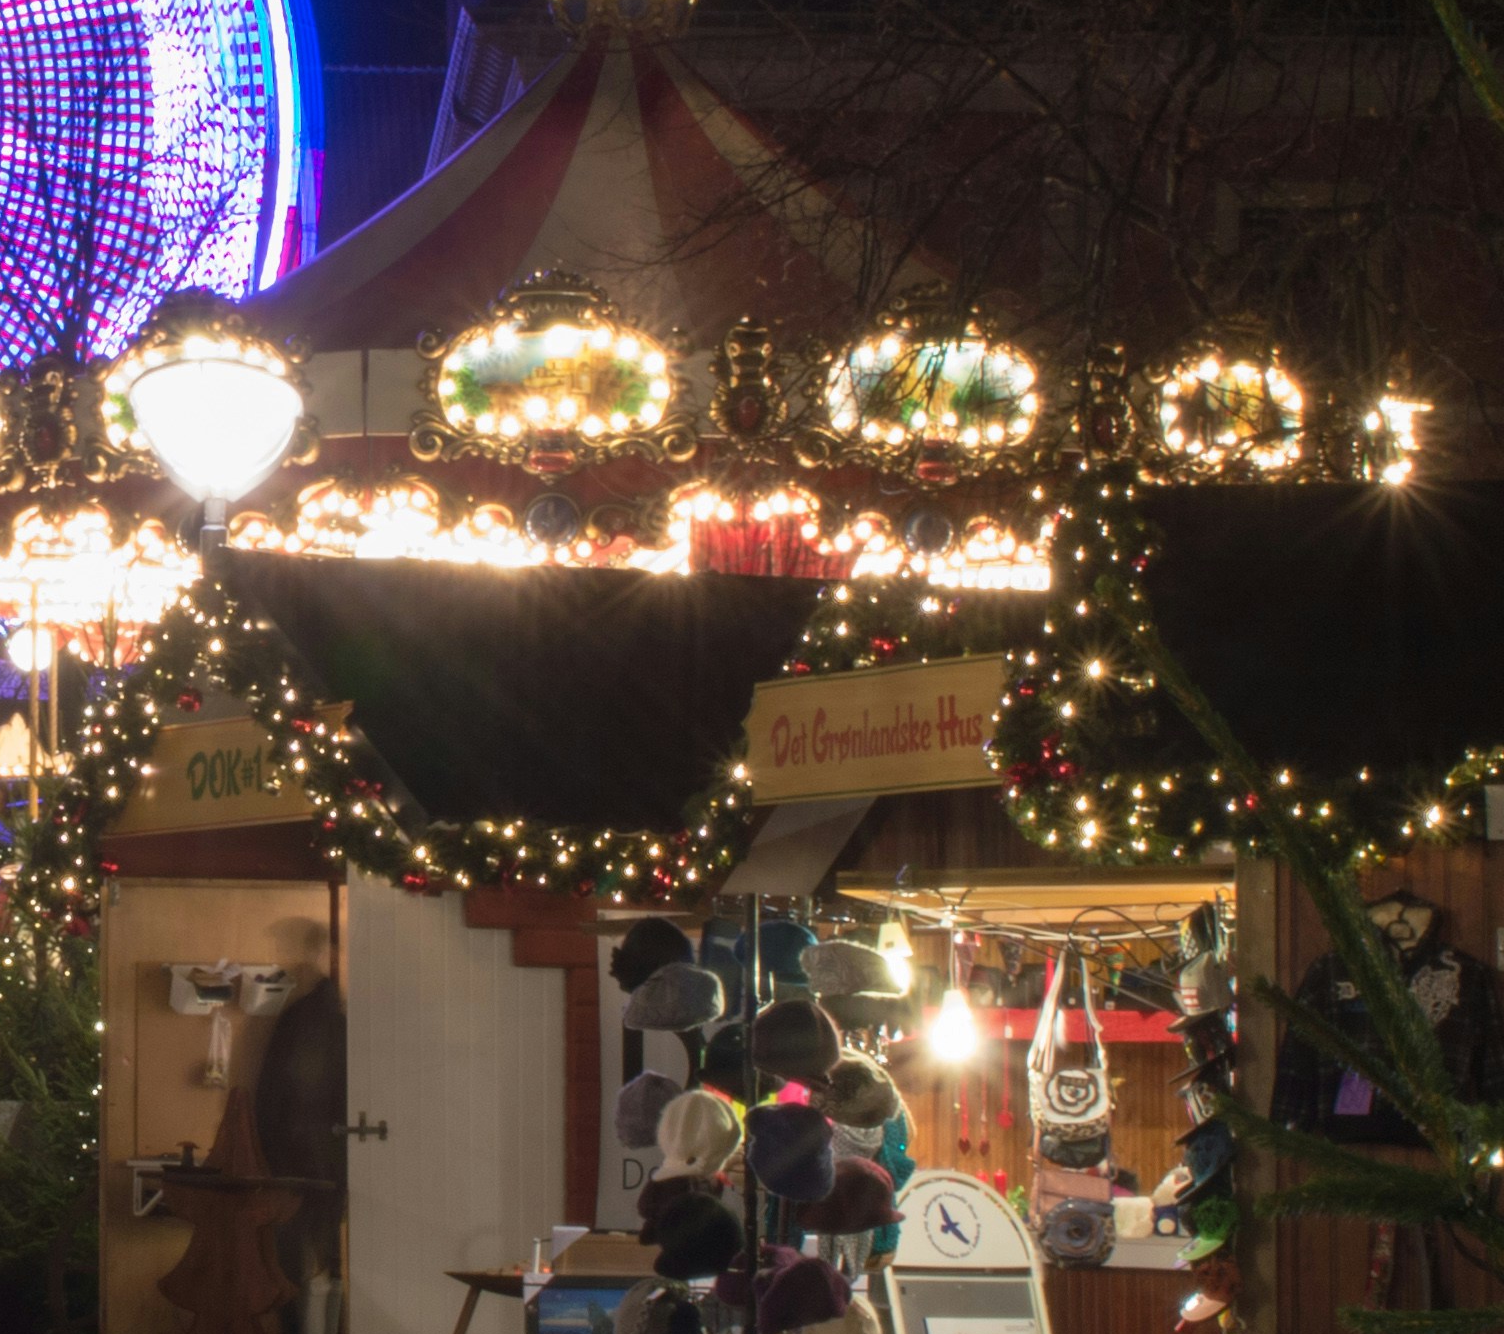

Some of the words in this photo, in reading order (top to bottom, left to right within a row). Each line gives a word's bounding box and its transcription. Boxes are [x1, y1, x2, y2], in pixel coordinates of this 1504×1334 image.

[770, 714, 808, 768] Det
[812, 702, 932, 765] Grønlandske
[936, 694, 984, 751] Hus
